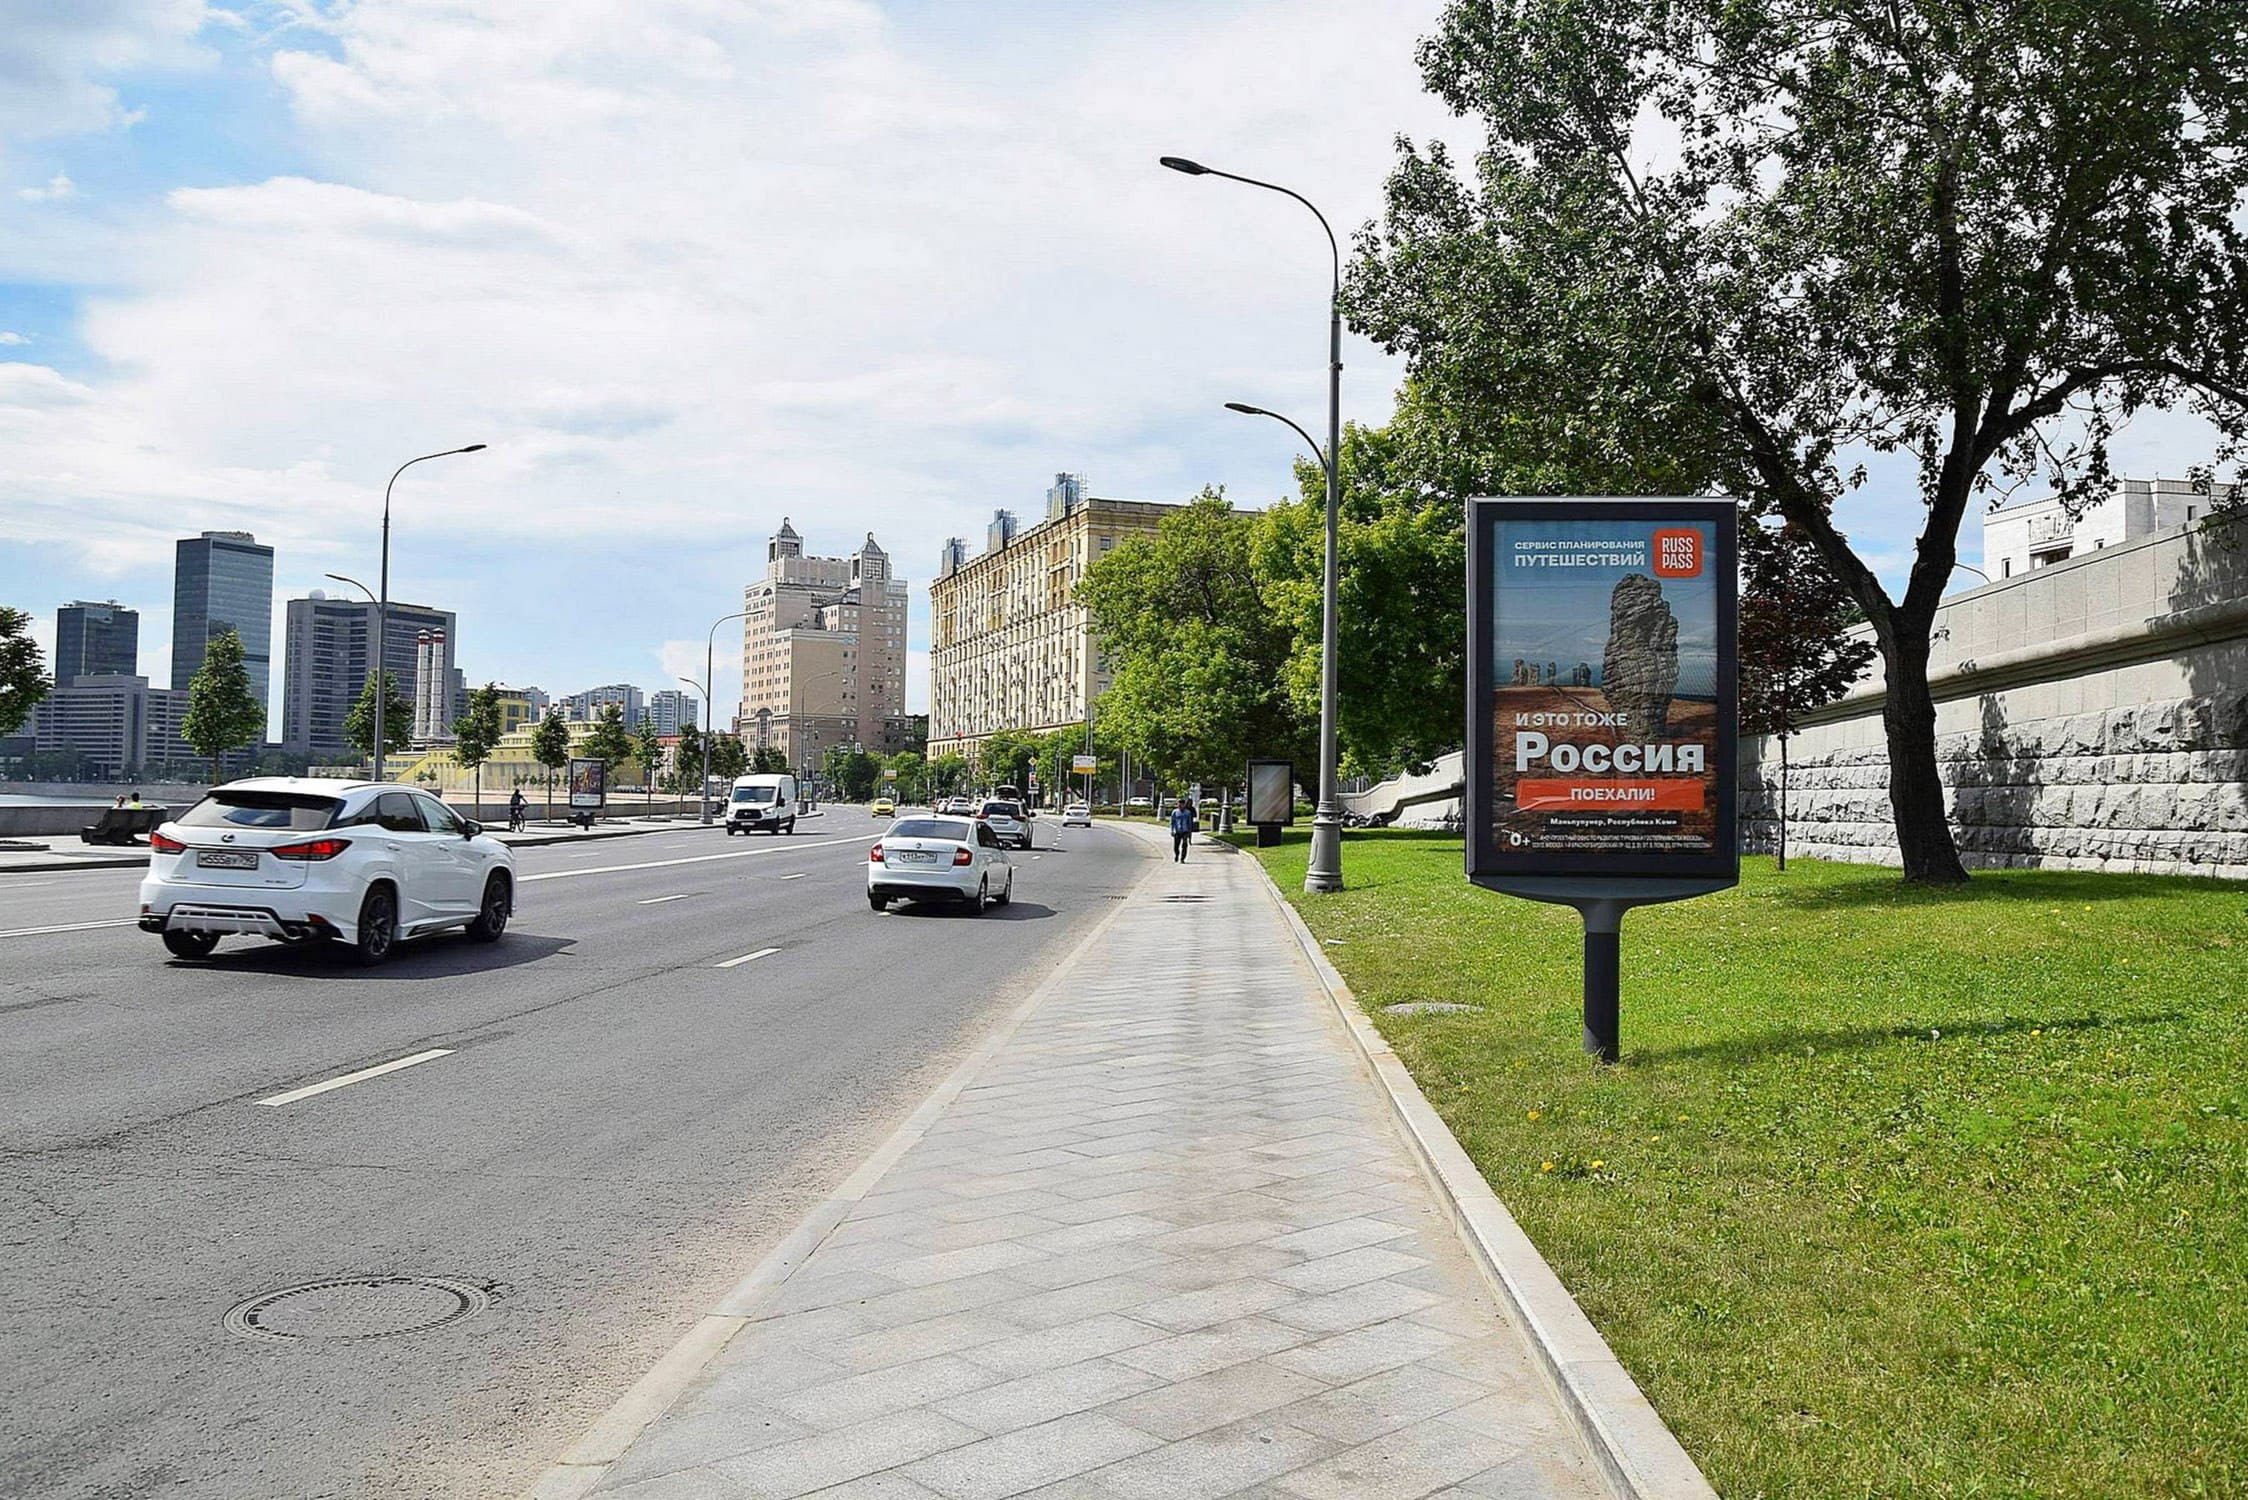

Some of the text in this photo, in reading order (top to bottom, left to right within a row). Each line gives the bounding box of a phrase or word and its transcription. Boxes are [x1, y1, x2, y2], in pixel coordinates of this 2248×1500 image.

[1514, 540, 1645, 550] СЕРВИС ПЛАНИРОВАНИЯ
[1661, 536, 1694, 553] RUSS
[1514, 551, 1646, 567] ПУТЕШЕСТВИЙ
[1661, 553, 1694, 569] PASS
[1515, 713, 1628, 727] И ЭТО ТОЖЕ
[1570, 788, 1656, 801] ПОЕХАЛИ!
[1607, 818, 1654, 827] Республика
[1510, 832, 1531, 847] 0+
